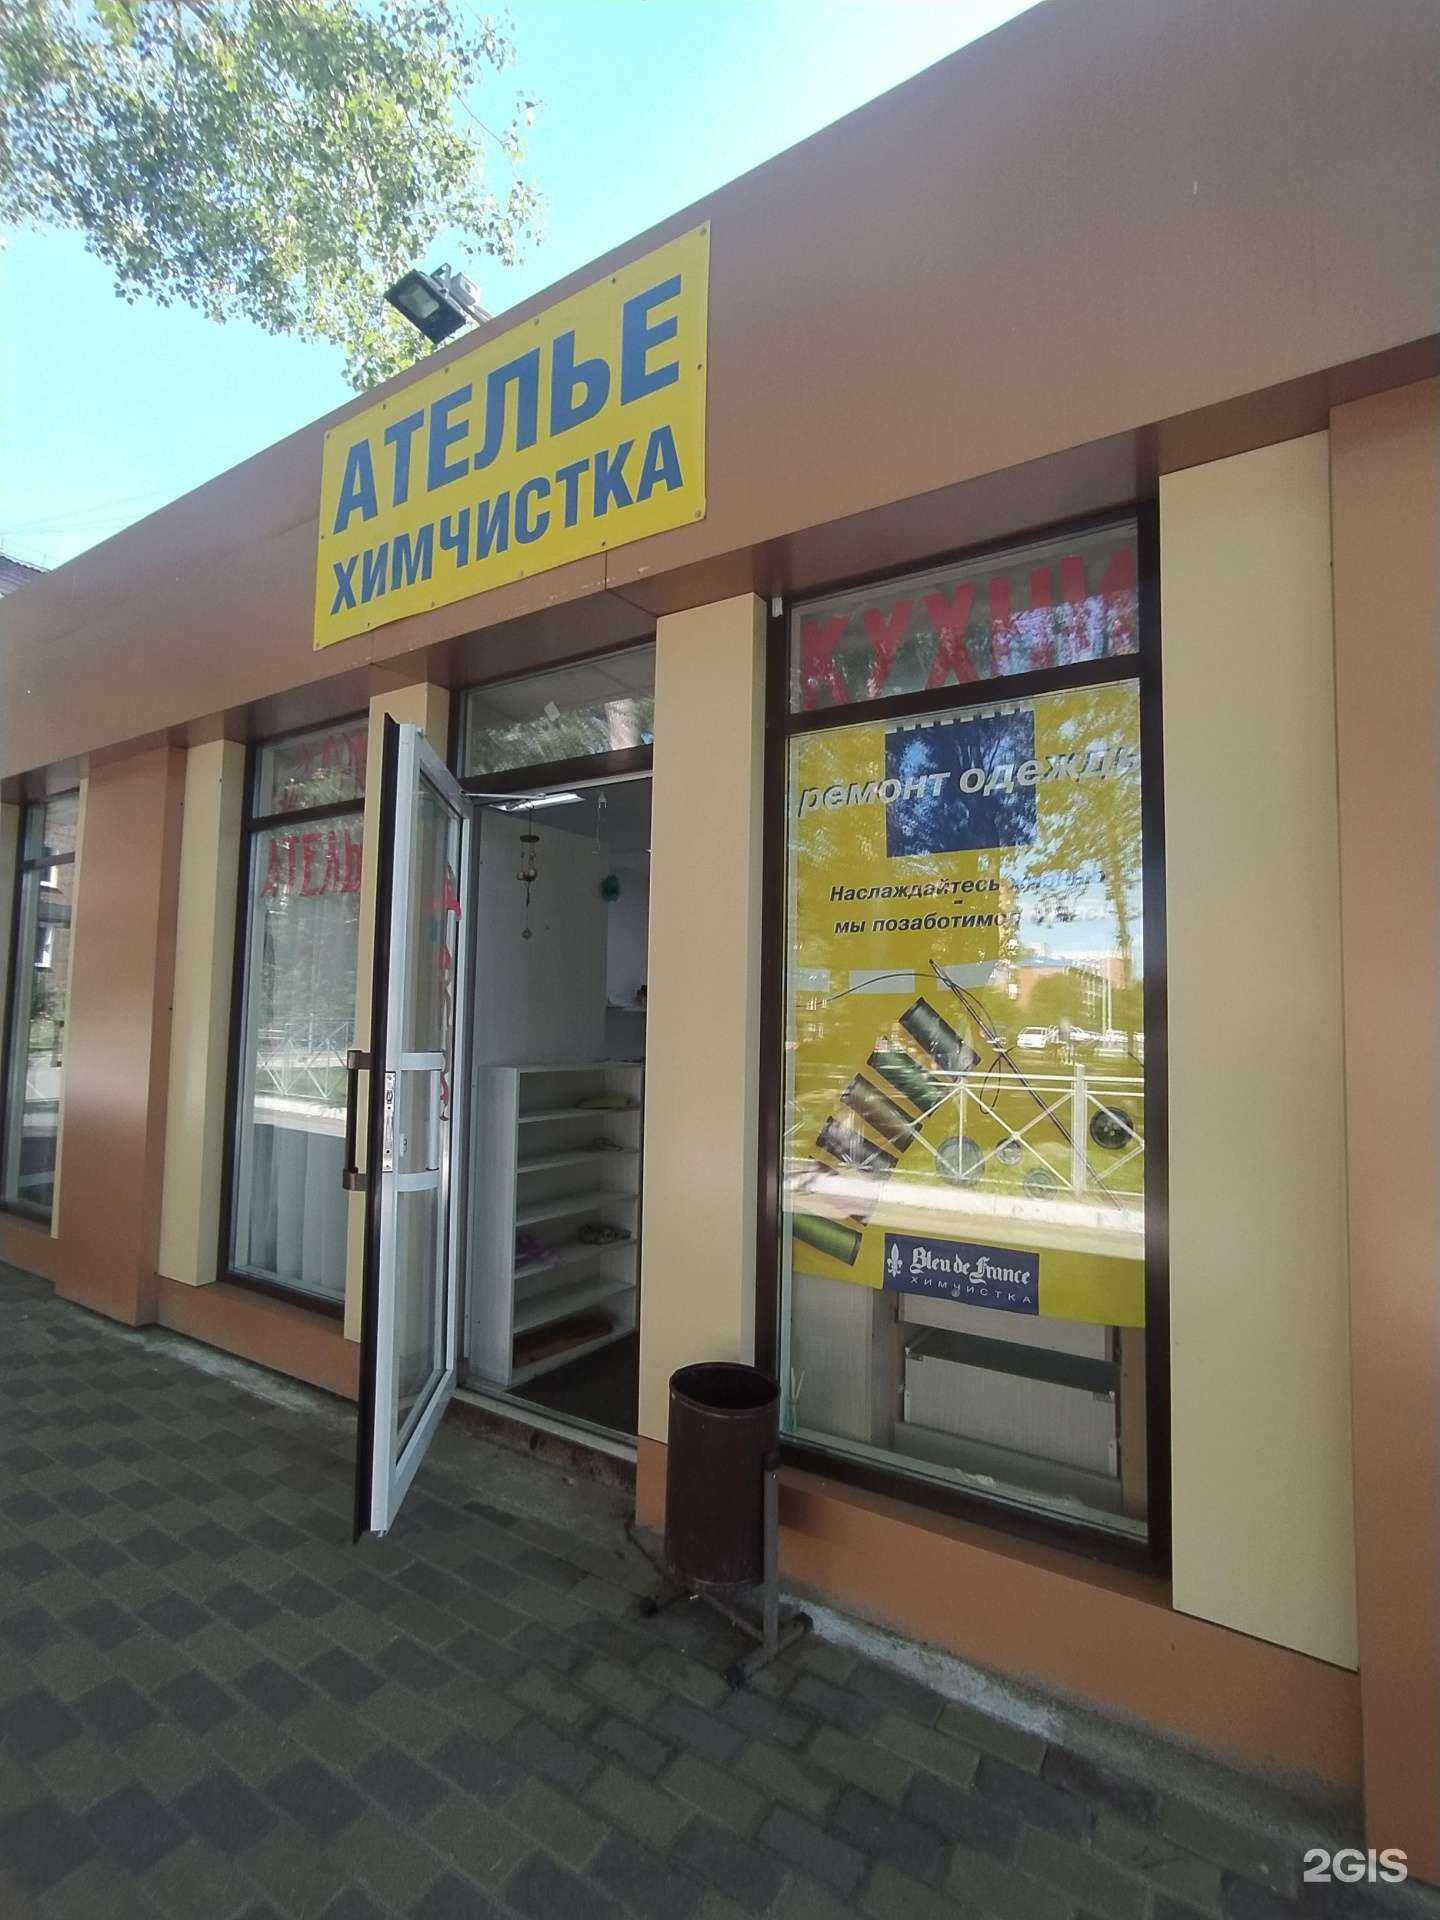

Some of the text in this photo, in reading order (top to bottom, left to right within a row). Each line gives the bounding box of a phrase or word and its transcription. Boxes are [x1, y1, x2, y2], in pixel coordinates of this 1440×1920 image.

[332, 273, 682, 536] АТЕЛЬЕ
[329, 423, 685, 616] ХИМЧИСТКА
[797, 771, 951, 818] ремонт
[259, 828, 362, 898] АТЕЛЬ
[829, 878, 1000, 902] Наслаждайтесь
[834, 920, 866, 934] мы
[909, 1245, 1032, 1285] Bleu de France
